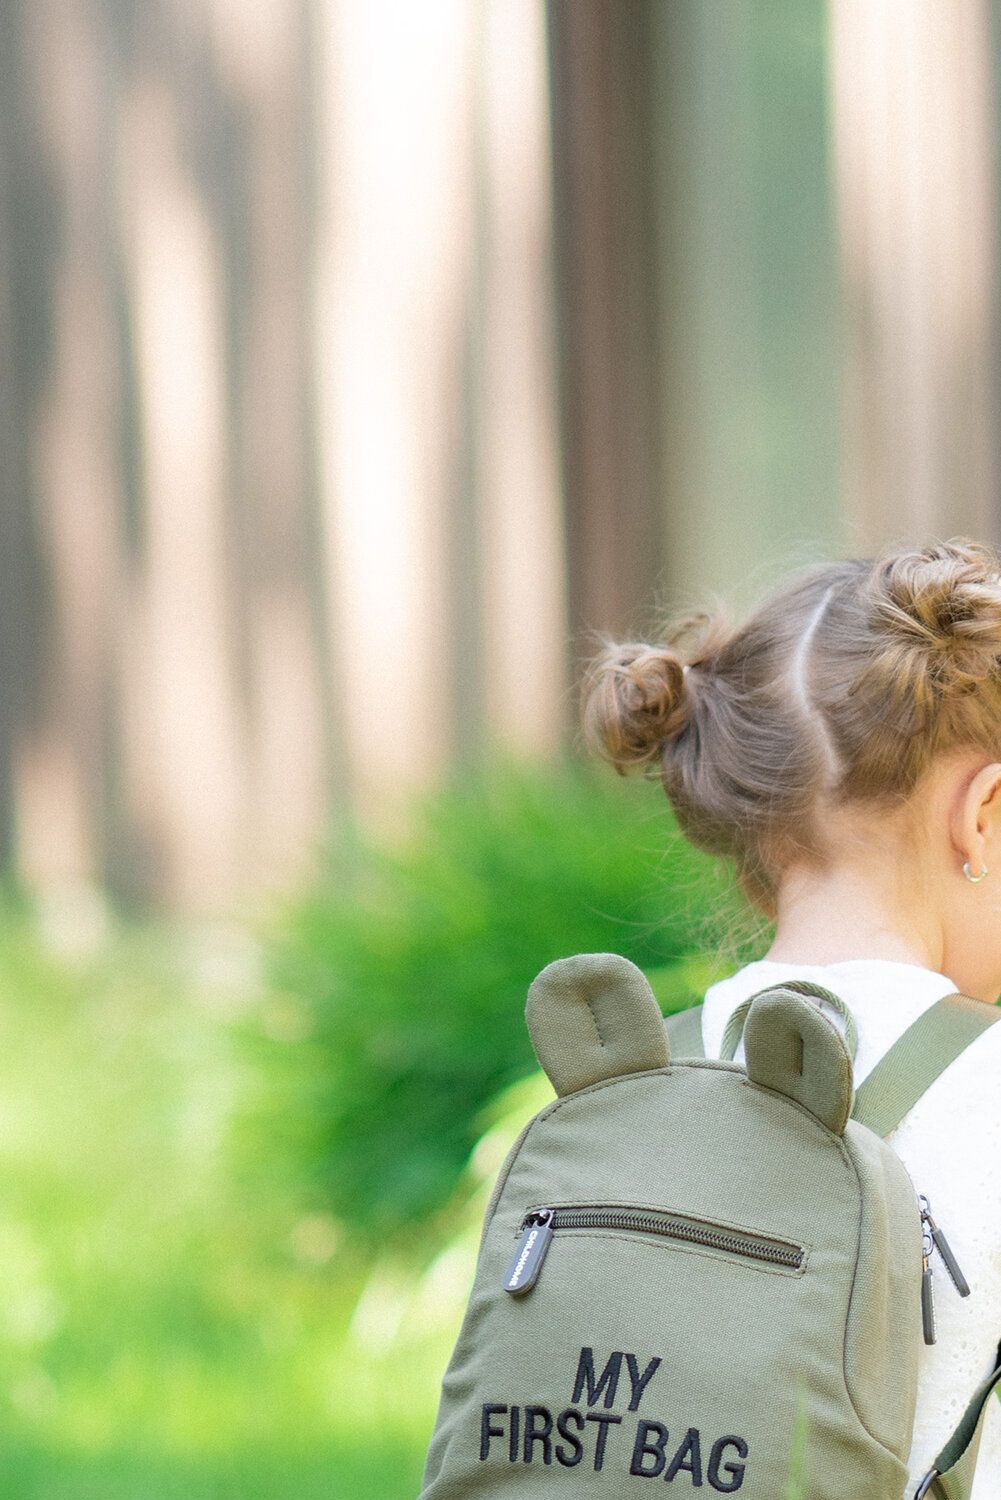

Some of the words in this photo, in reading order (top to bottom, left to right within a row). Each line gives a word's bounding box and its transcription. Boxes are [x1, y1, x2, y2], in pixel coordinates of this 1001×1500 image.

[509, 1230, 538, 1286] CHILDHOME
[571, 1347, 662, 1411] MY
[479, 1403, 622, 1471] FIRST
[630, 1421, 749, 1493] BAG
